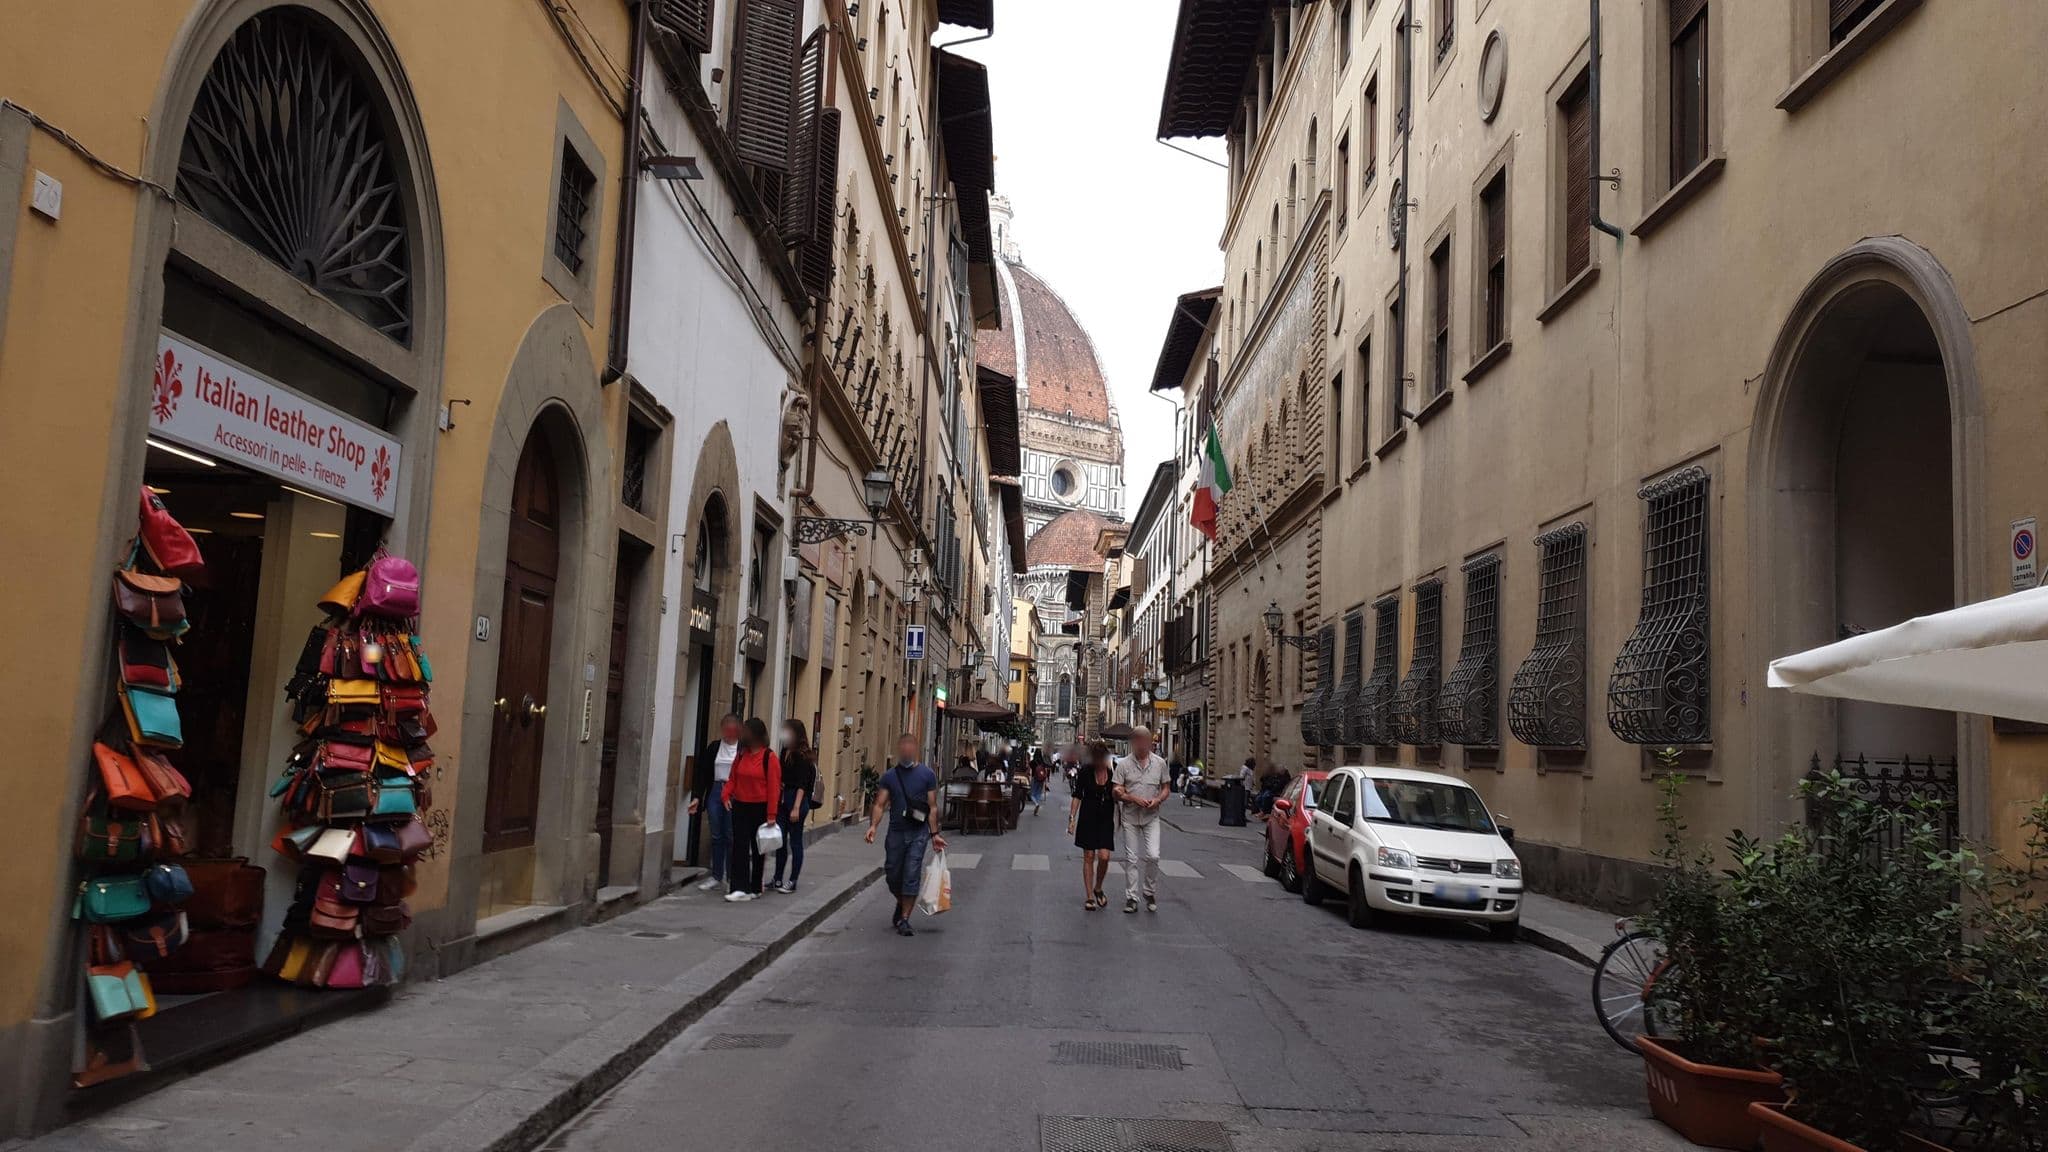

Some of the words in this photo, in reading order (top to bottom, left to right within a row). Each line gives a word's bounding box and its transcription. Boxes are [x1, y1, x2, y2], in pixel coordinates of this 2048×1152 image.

[195, 366, 259, 423] Italian
[263, 394, 325, 449] leather
[327, 425, 366, 472] Shop
[214, 423, 268, 460] Accessori
[269, 444, 280, 465] in
[281, 452, 306, 474] pelle
[313, 461, 346, 489] Firenze
